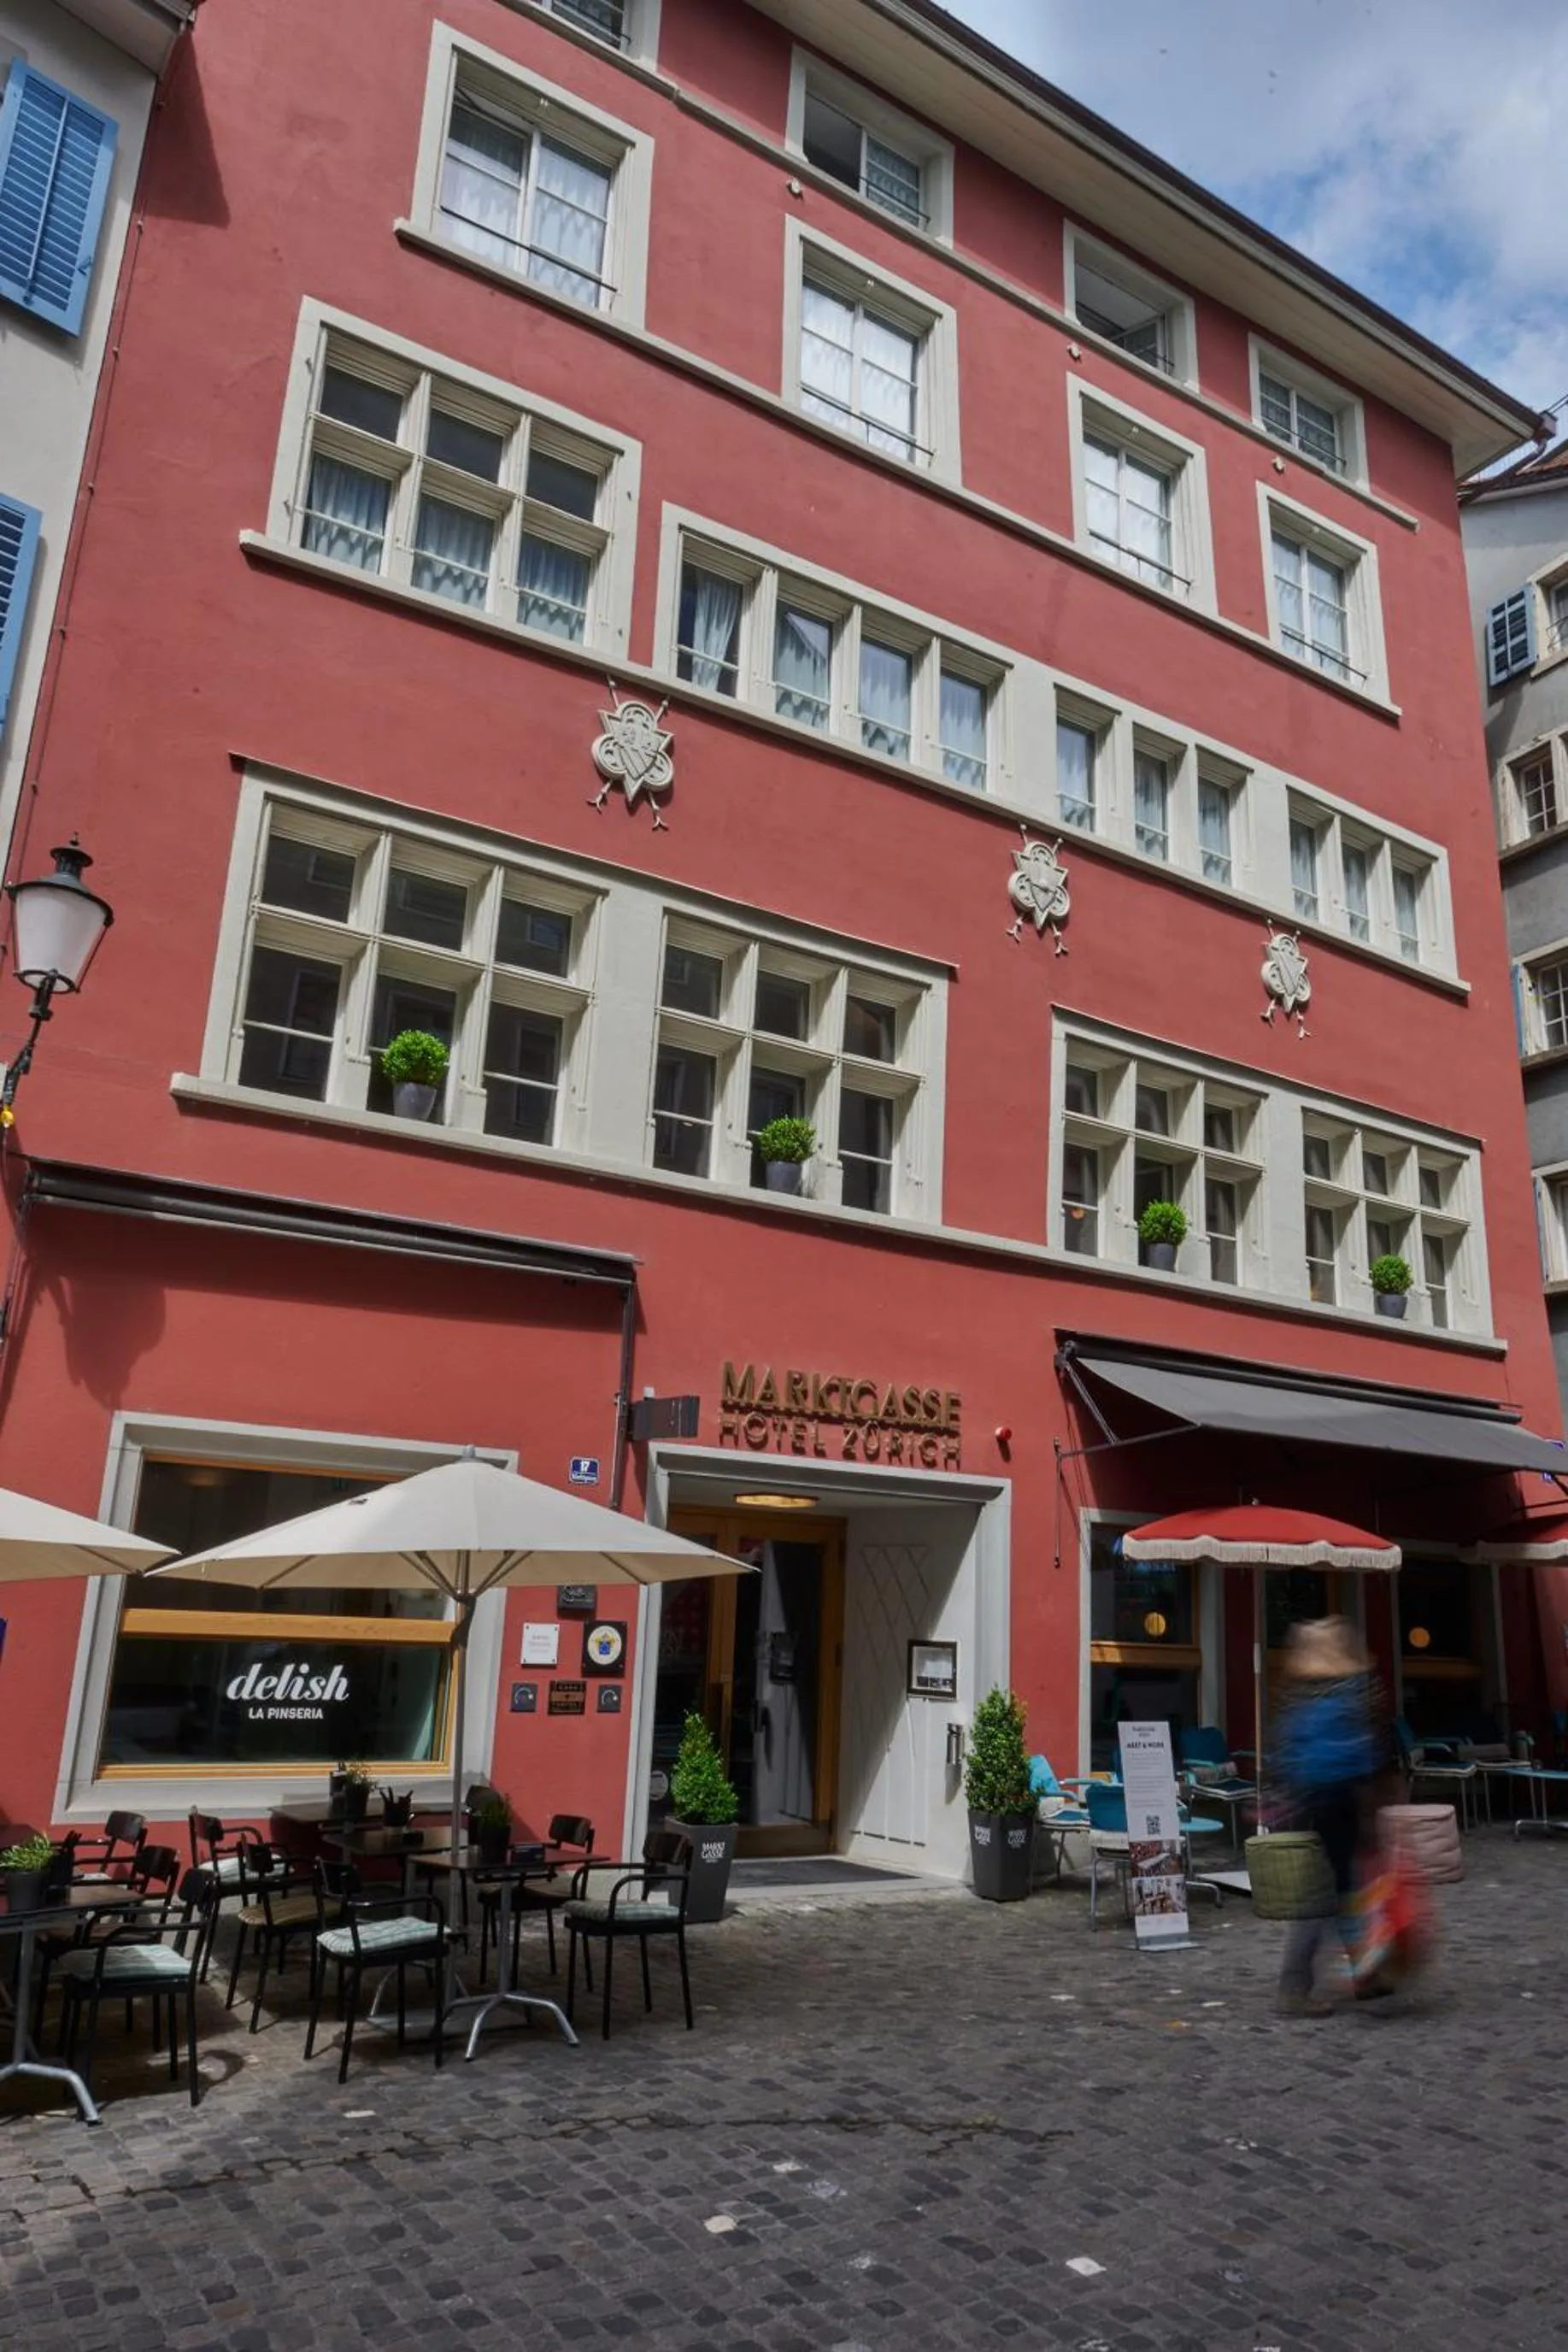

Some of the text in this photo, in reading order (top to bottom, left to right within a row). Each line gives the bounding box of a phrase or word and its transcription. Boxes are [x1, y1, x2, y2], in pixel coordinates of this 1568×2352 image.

[722, 1361, 962, 1428] MARKTGASSE
[719, 1410, 961, 1469] HOTEL ZÜRICH
[580, 1461, 590, 1473] 17
[226, 1662, 349, 1701] delish
[249, 1707, 324, 1720] LA PINSERIA
